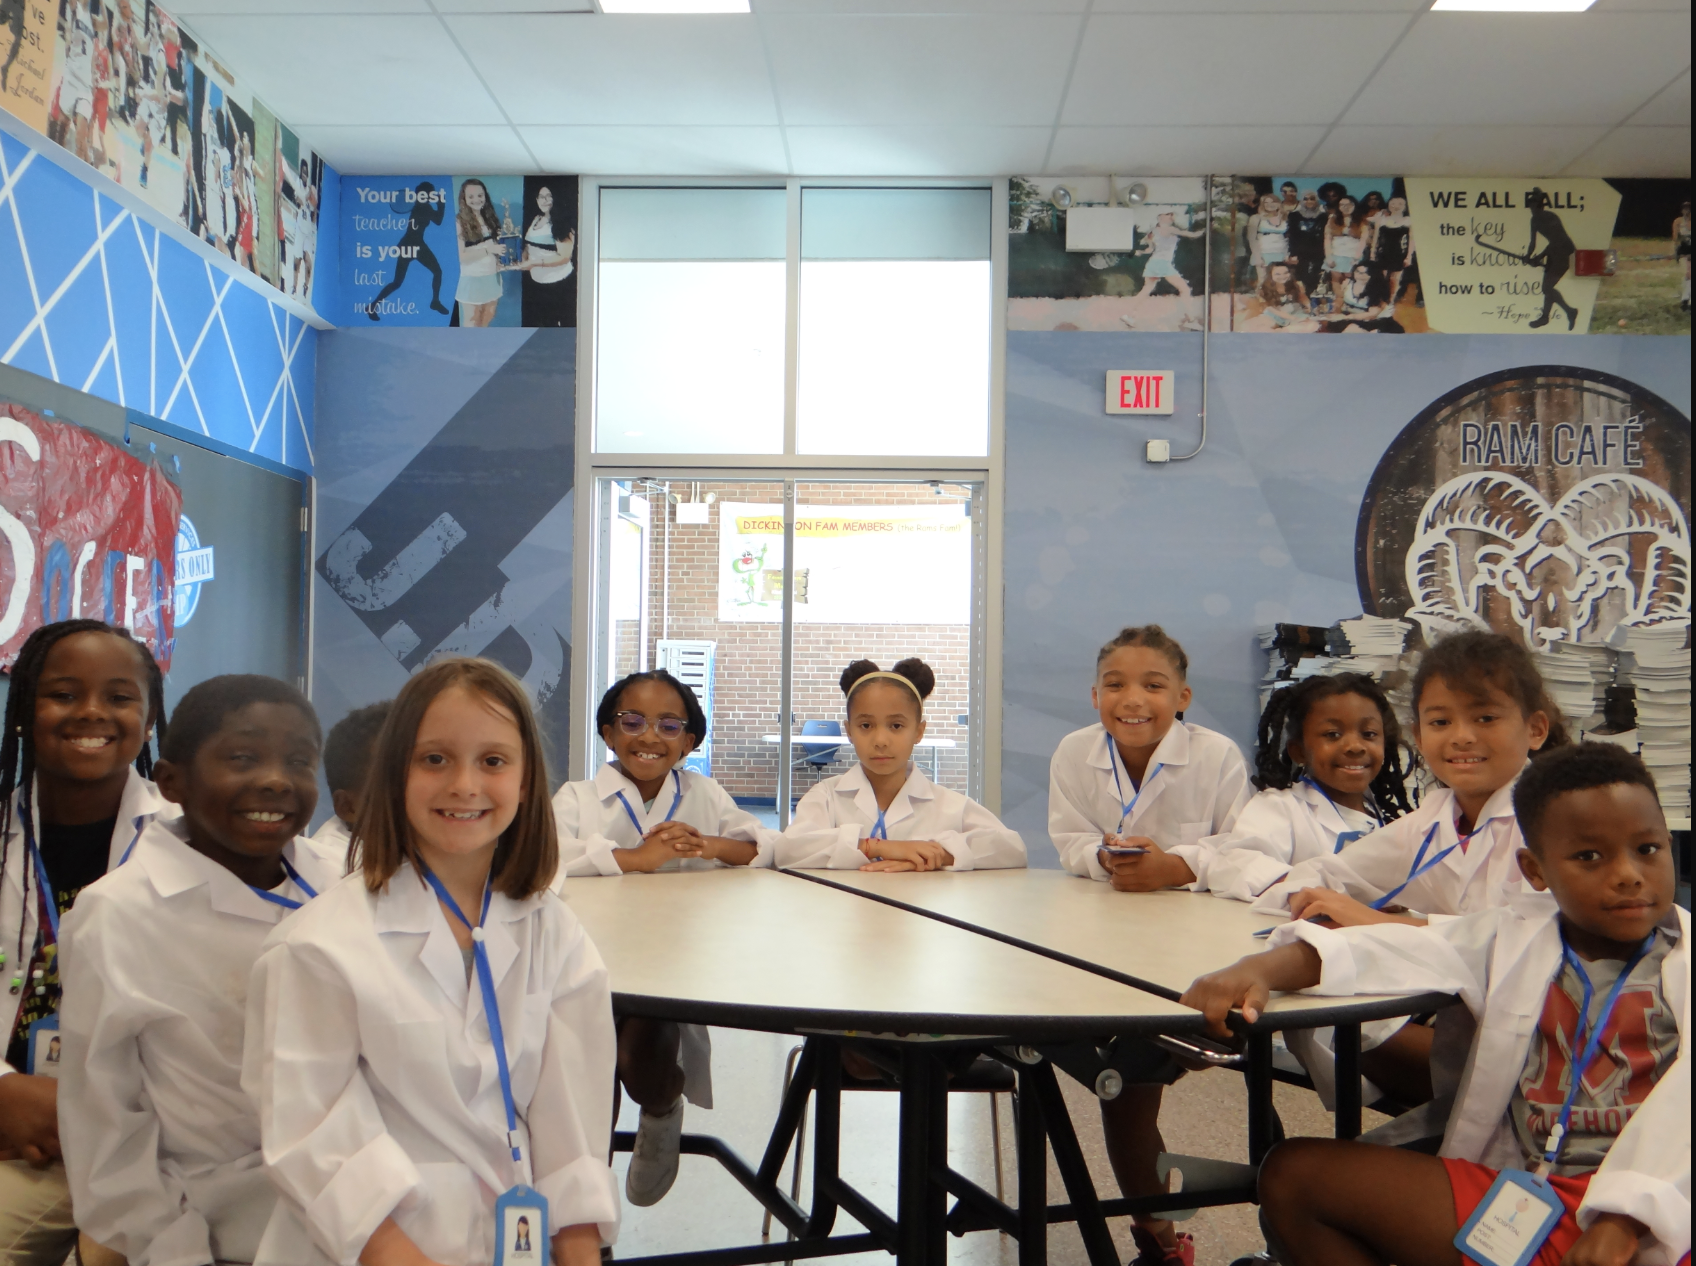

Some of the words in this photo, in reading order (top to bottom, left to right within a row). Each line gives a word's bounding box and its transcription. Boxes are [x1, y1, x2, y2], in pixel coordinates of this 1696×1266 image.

[356, 187, 401, 204] Your
[405, 187, 447, 204] best
[1430, 191, 1468, 209] WE
[1475, 191, 1516, 209] ALL
[352, 214, 419, 231] teacher
[1440, 222, 1466, 236] the
[1470, 216, 1507, 242] key
[356, 242, 373, 258] is
[378, 244, 420, 262] your
[1451, 253, 1465, 266] is
[354, 269, 387, 285] last
[1438, 281, 1473, 295] how
[1479, 282, 1495, 295] to
[1501, 274, 1545, 295] rise
[354, 296, 420, 314] mistake.
[1120, 375, 1164, 409] EXIT
[1459, 421, 1541, 467] RAM
[1552, 414, 1643, 468] CAFÉ
[743, 520, 812, 531] DICKINON
[815, 521, 839, 531] FAM
[842, 522, 894, 532] MEMBERS
[188, 553, 211, 578] ONLY
[1493, 1215, 1520, 1237] HOSPITAL
